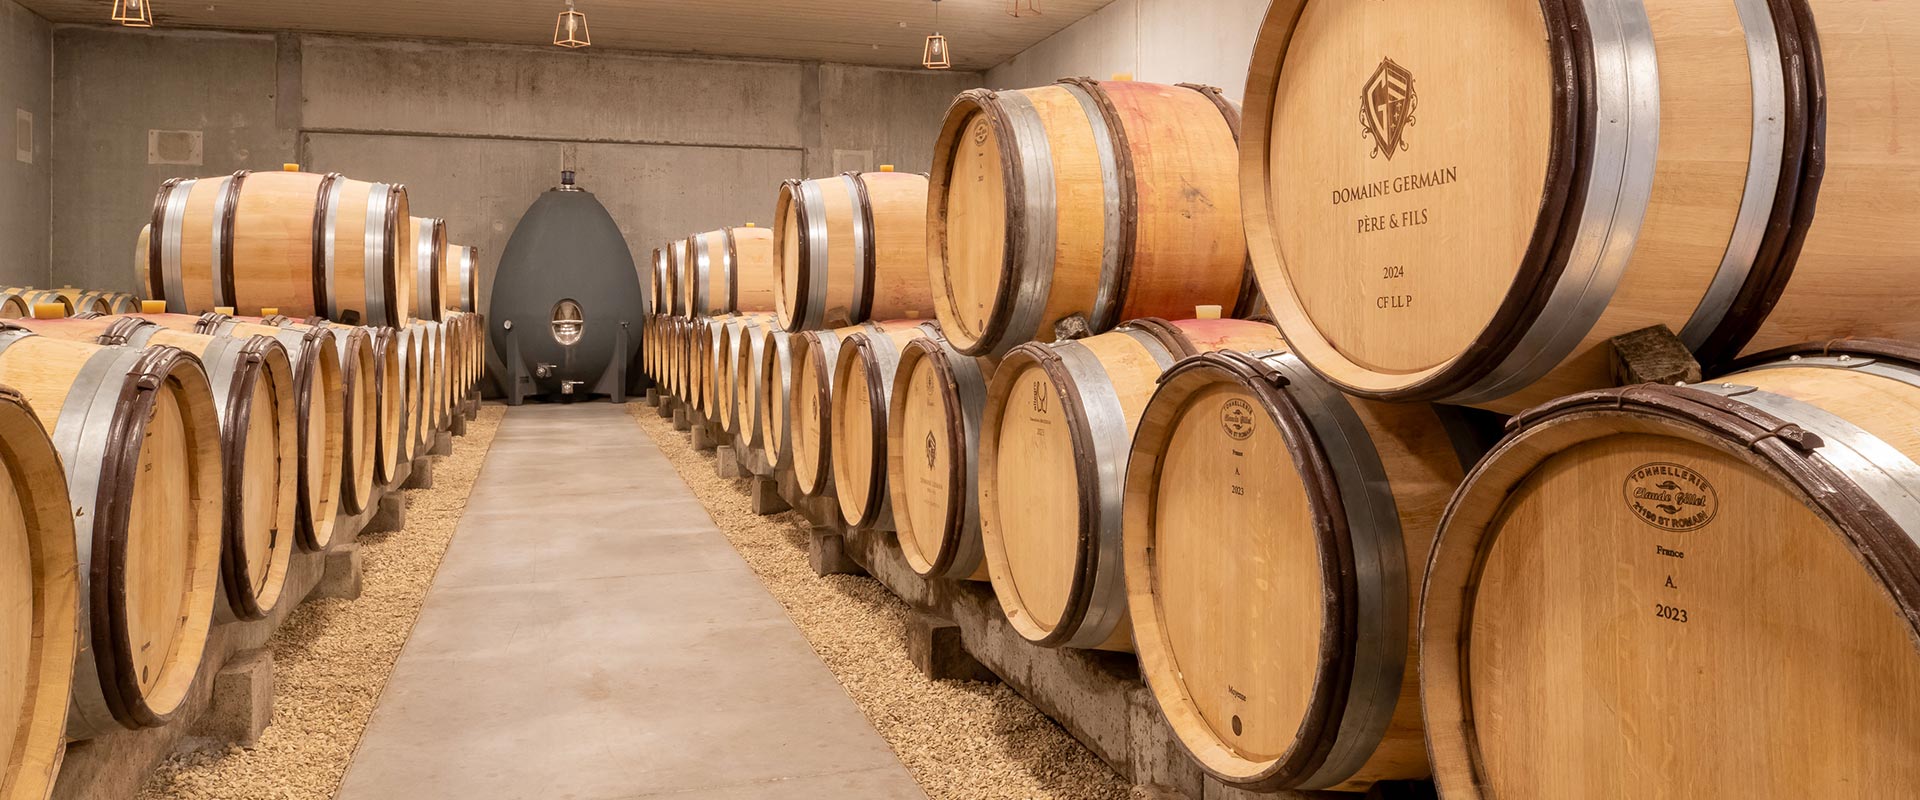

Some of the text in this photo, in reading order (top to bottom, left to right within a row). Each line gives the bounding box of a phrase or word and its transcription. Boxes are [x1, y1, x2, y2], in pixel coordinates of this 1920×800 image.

[1332, 166, 1457, 205] DOMAINE GERMAIN
[1357, 208, 1429, 234] PÈRE & FILS
[1383, 265, 1404, 279] 2024
[1376, 295, 1413, 309] CF LL P
[1631, 466, 1708, 492] TONNELLERIE
[1231, 485, 1244, 496] 2023
[1633, 486, 1707, 507] Claude Gillet
[1658, 516, 1670, 526] ST
[1671, 510, 1709, 528] ROMAIN
[1656, 545, 1684, 559] France
[1664, 574, 1678, 589] A.
[1656, 603, 1688, 623] 2023
